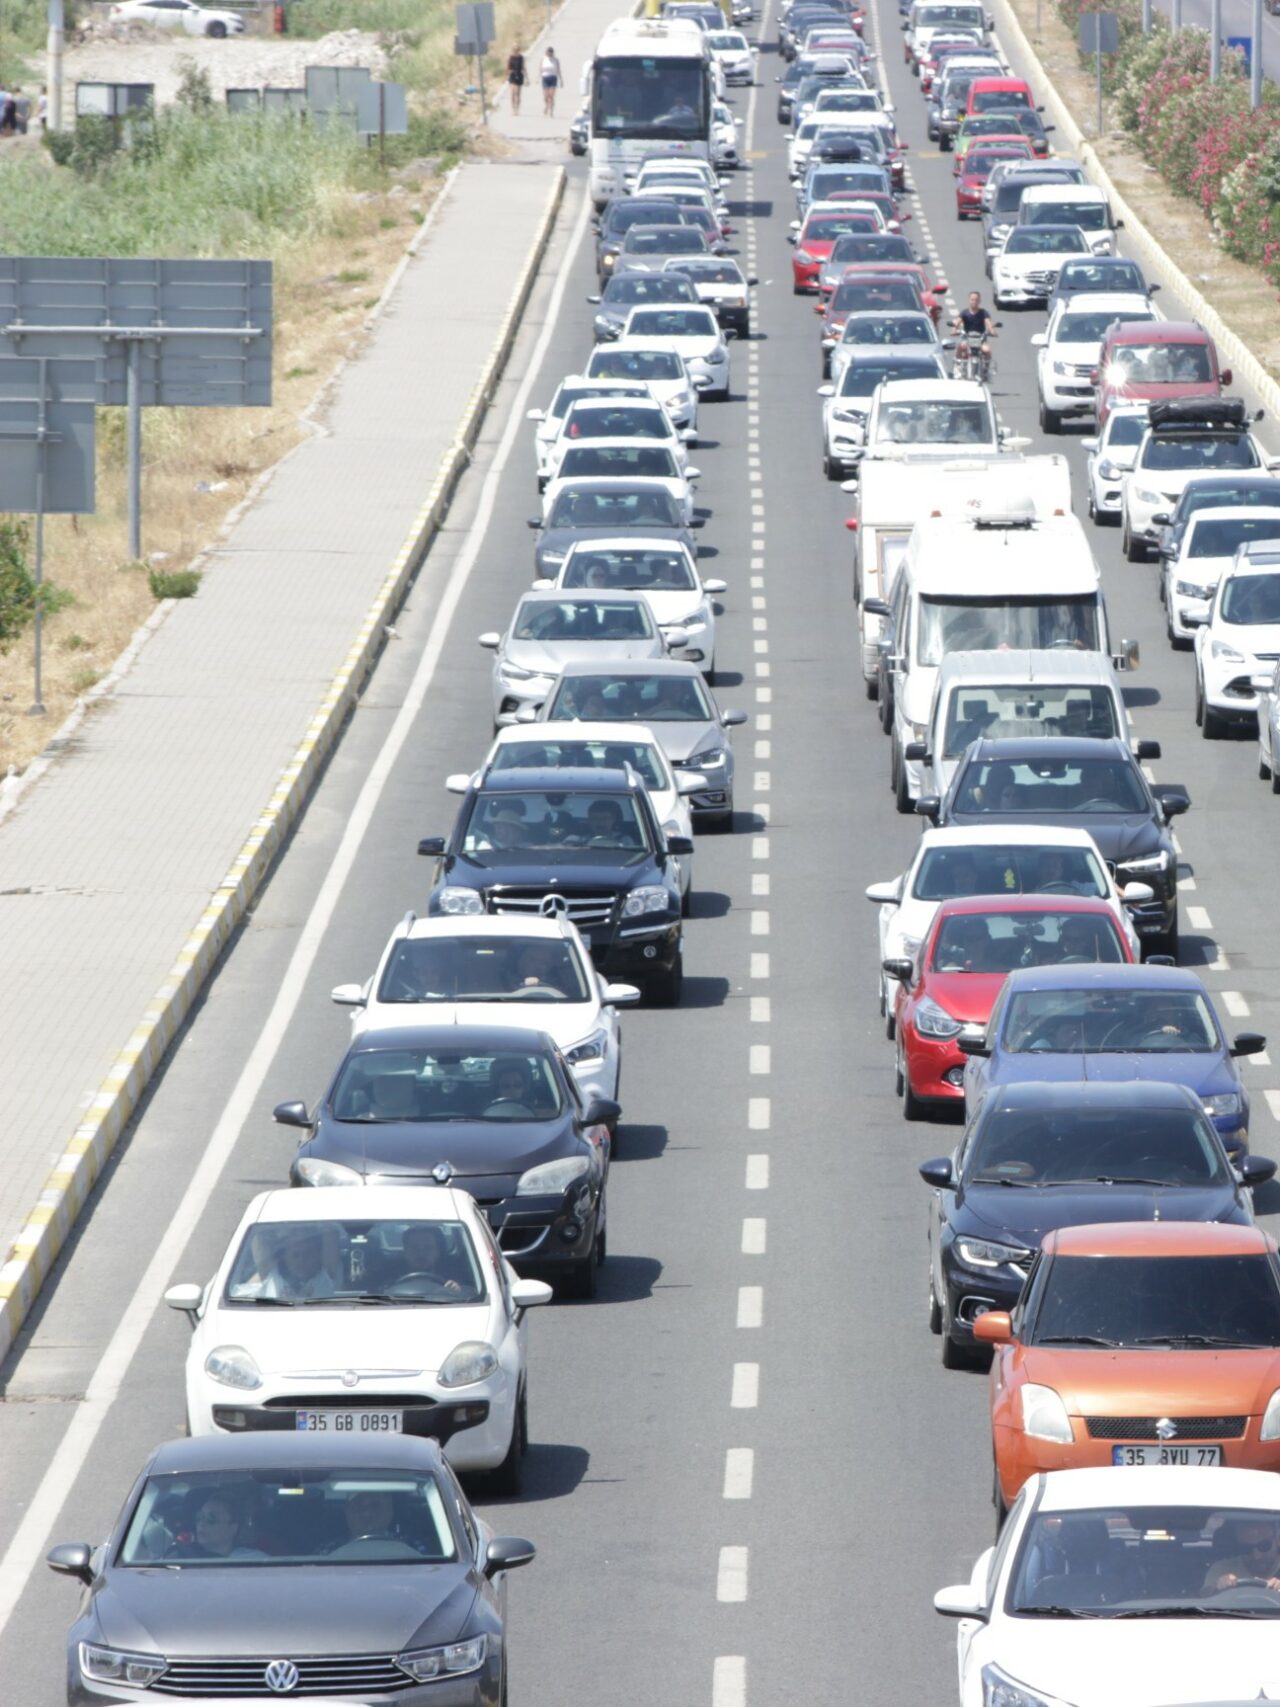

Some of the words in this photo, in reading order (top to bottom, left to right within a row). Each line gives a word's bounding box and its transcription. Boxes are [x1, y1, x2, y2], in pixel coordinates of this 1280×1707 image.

[308, 1414, 327, 1431] 35
[335, 1414, 353, 1431] GB
[361, 1414, 397, 1431] 0891
[1126, 1449, 1145, 1466] 35
[1160, 1449, 1189, 1466] BVU
[1197, 1449, 1216, 1466] 77
